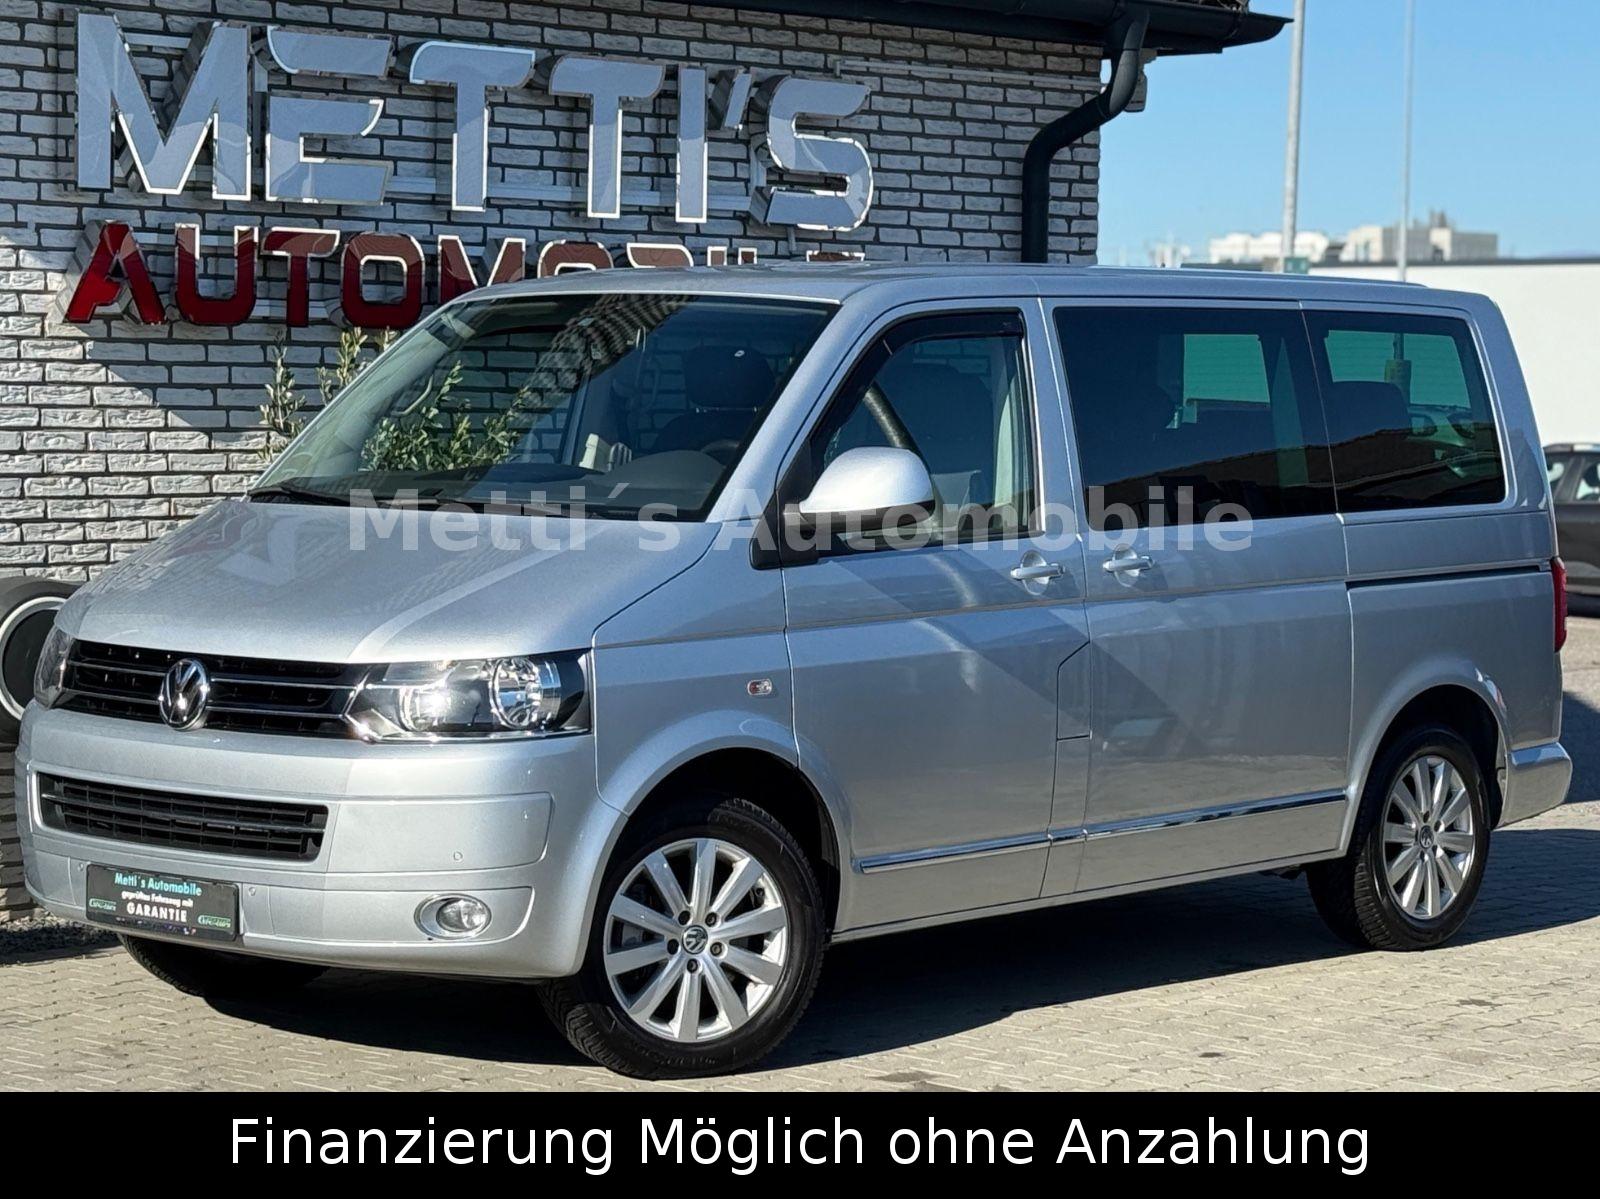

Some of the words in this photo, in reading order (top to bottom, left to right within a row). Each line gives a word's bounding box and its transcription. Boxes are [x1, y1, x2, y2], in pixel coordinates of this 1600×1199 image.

[74, 10, 876, 232] METTI'S
[147, 877, 203, 897] Automobile
[126, 901, 188, 923] GARANTIE
